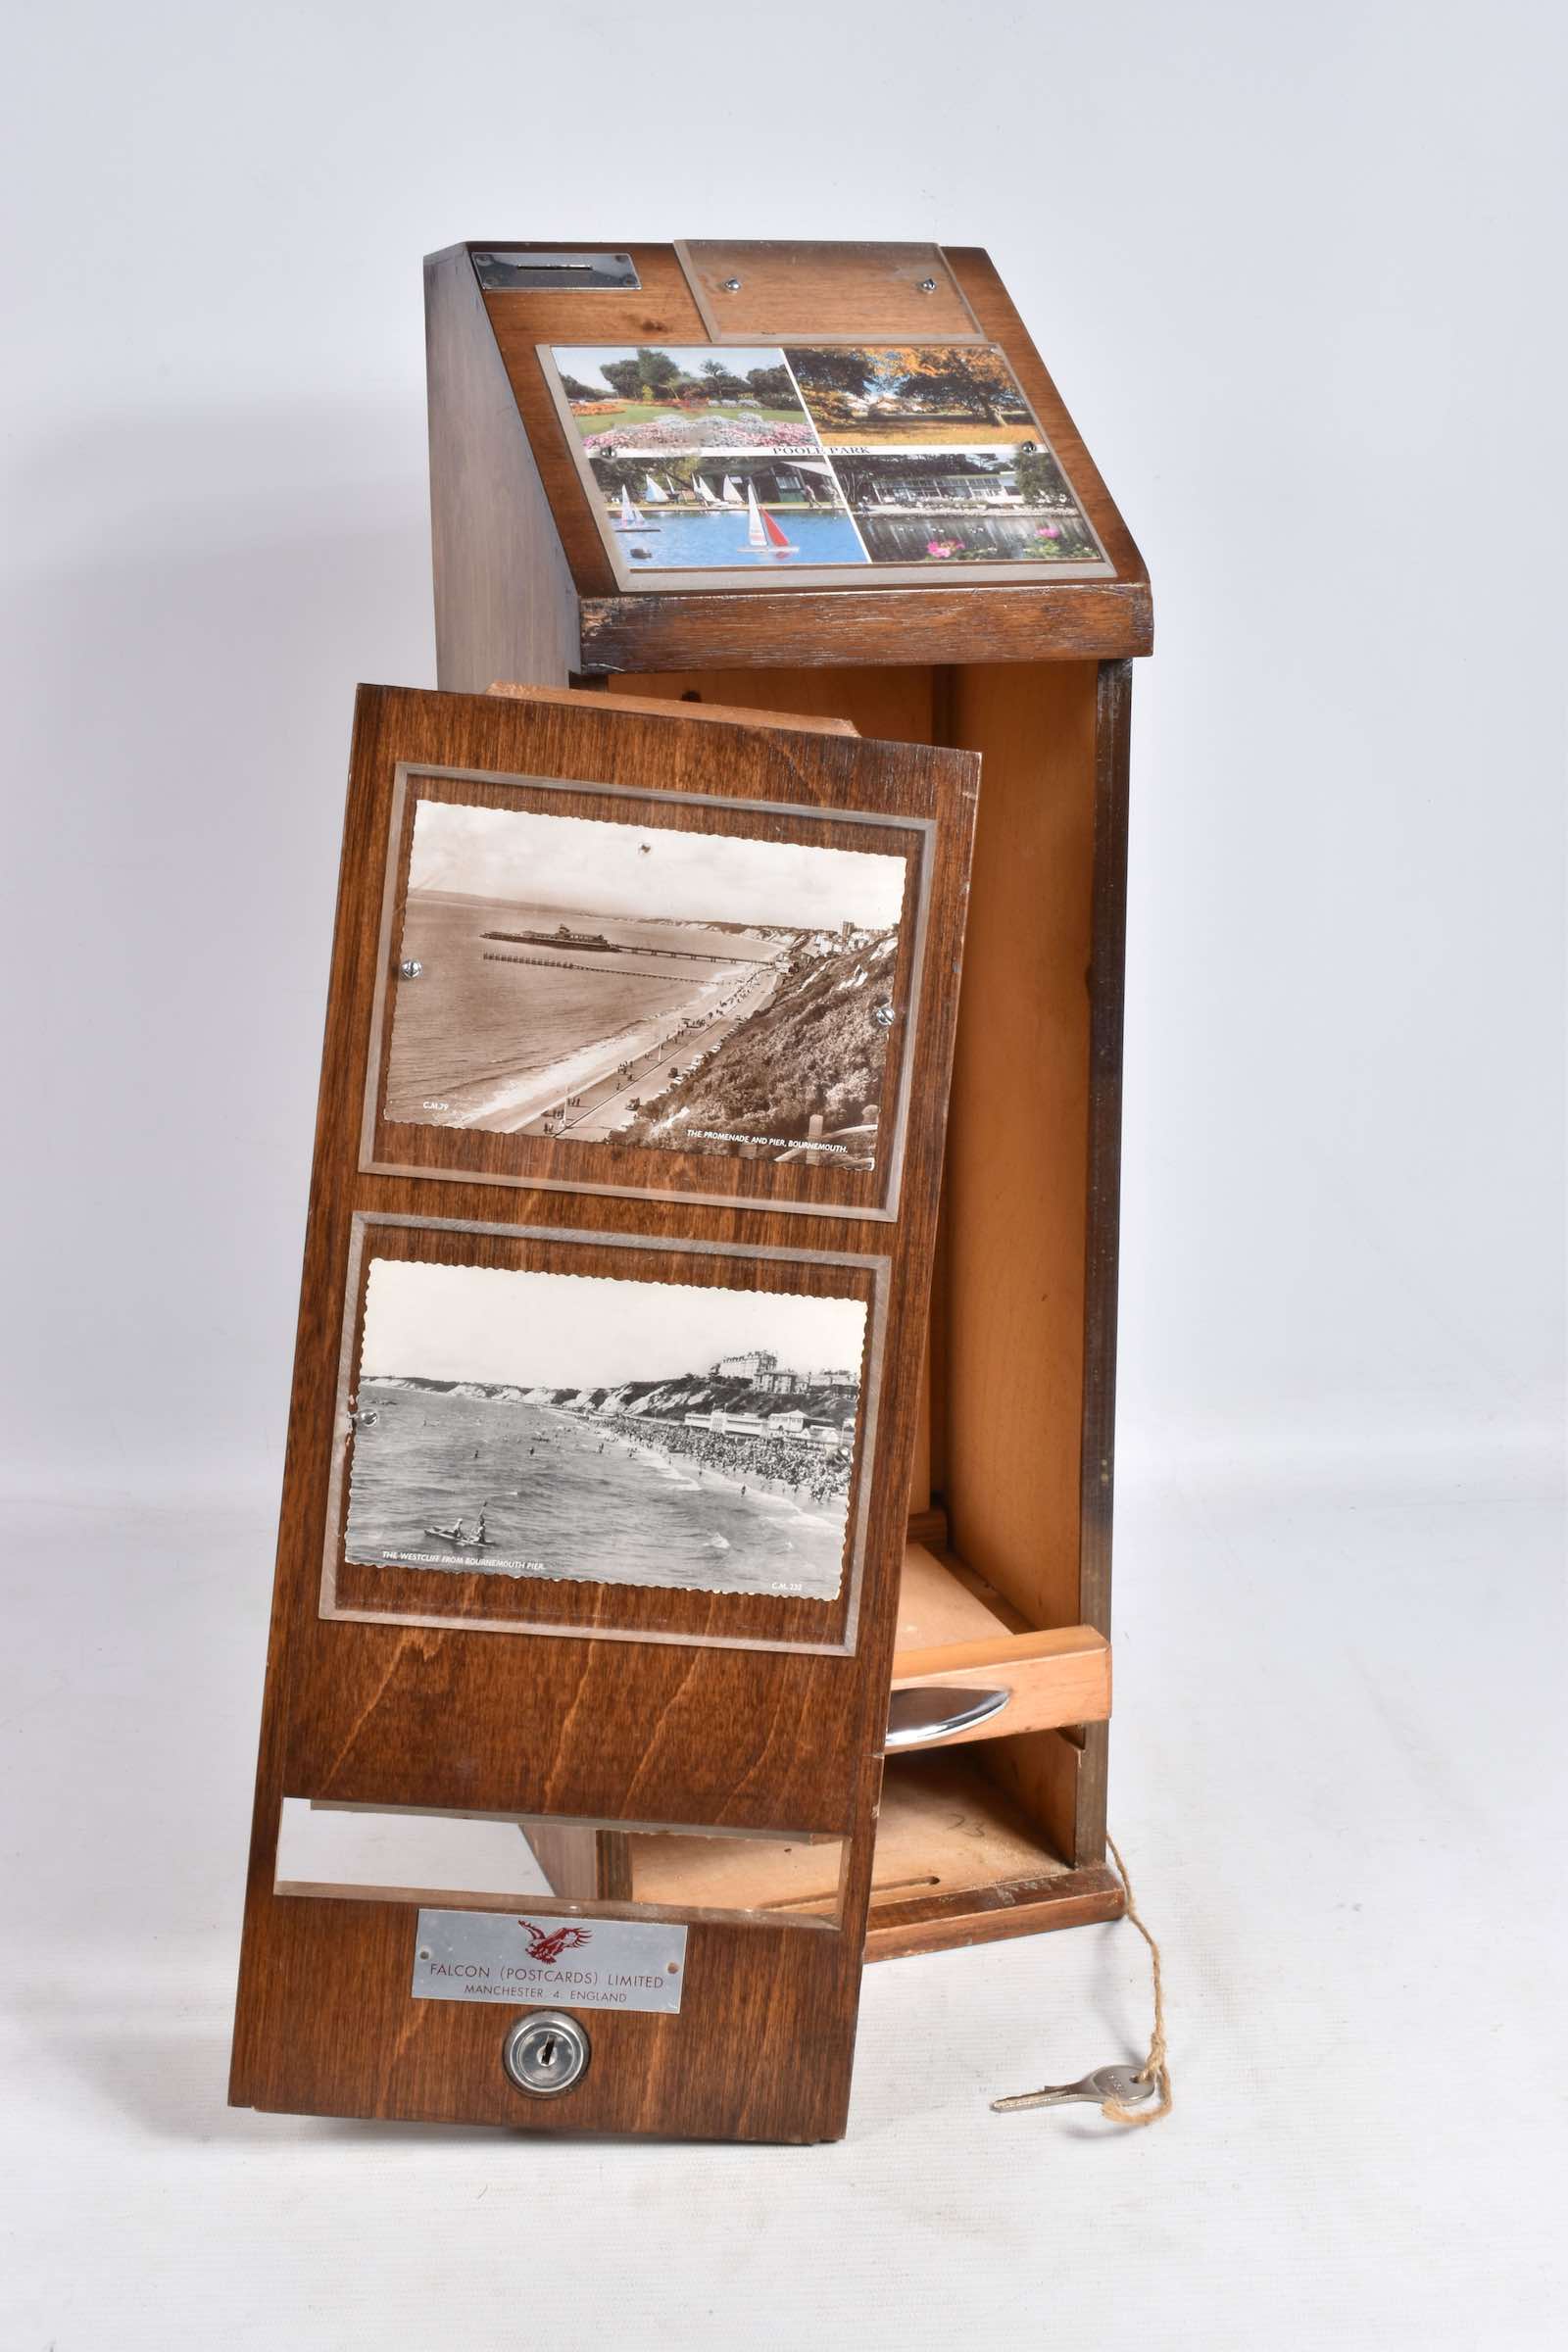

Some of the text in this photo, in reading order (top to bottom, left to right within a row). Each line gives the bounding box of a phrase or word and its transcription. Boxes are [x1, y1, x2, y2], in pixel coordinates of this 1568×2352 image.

[829, 446, 870, 455] PARK
[686, 1129, 849, 1153] THE PROMENADE AND PIER, BOURNEMOUTH.
[382, 1550, 397, 1559] THE
[400, 1551, 440, 1562] WESTCLIFF
[441, 1555, 464, 1565] FROM
[465, 1556, 525, 1569] BOURNEMOUTH
[429, 1963, 664, 1988] FALCON (POSTCARDS) LIMITED
[464, 1984, 544, 1998] MANCHESTER
[570, 1990, 628, 2003] ENGLAND
